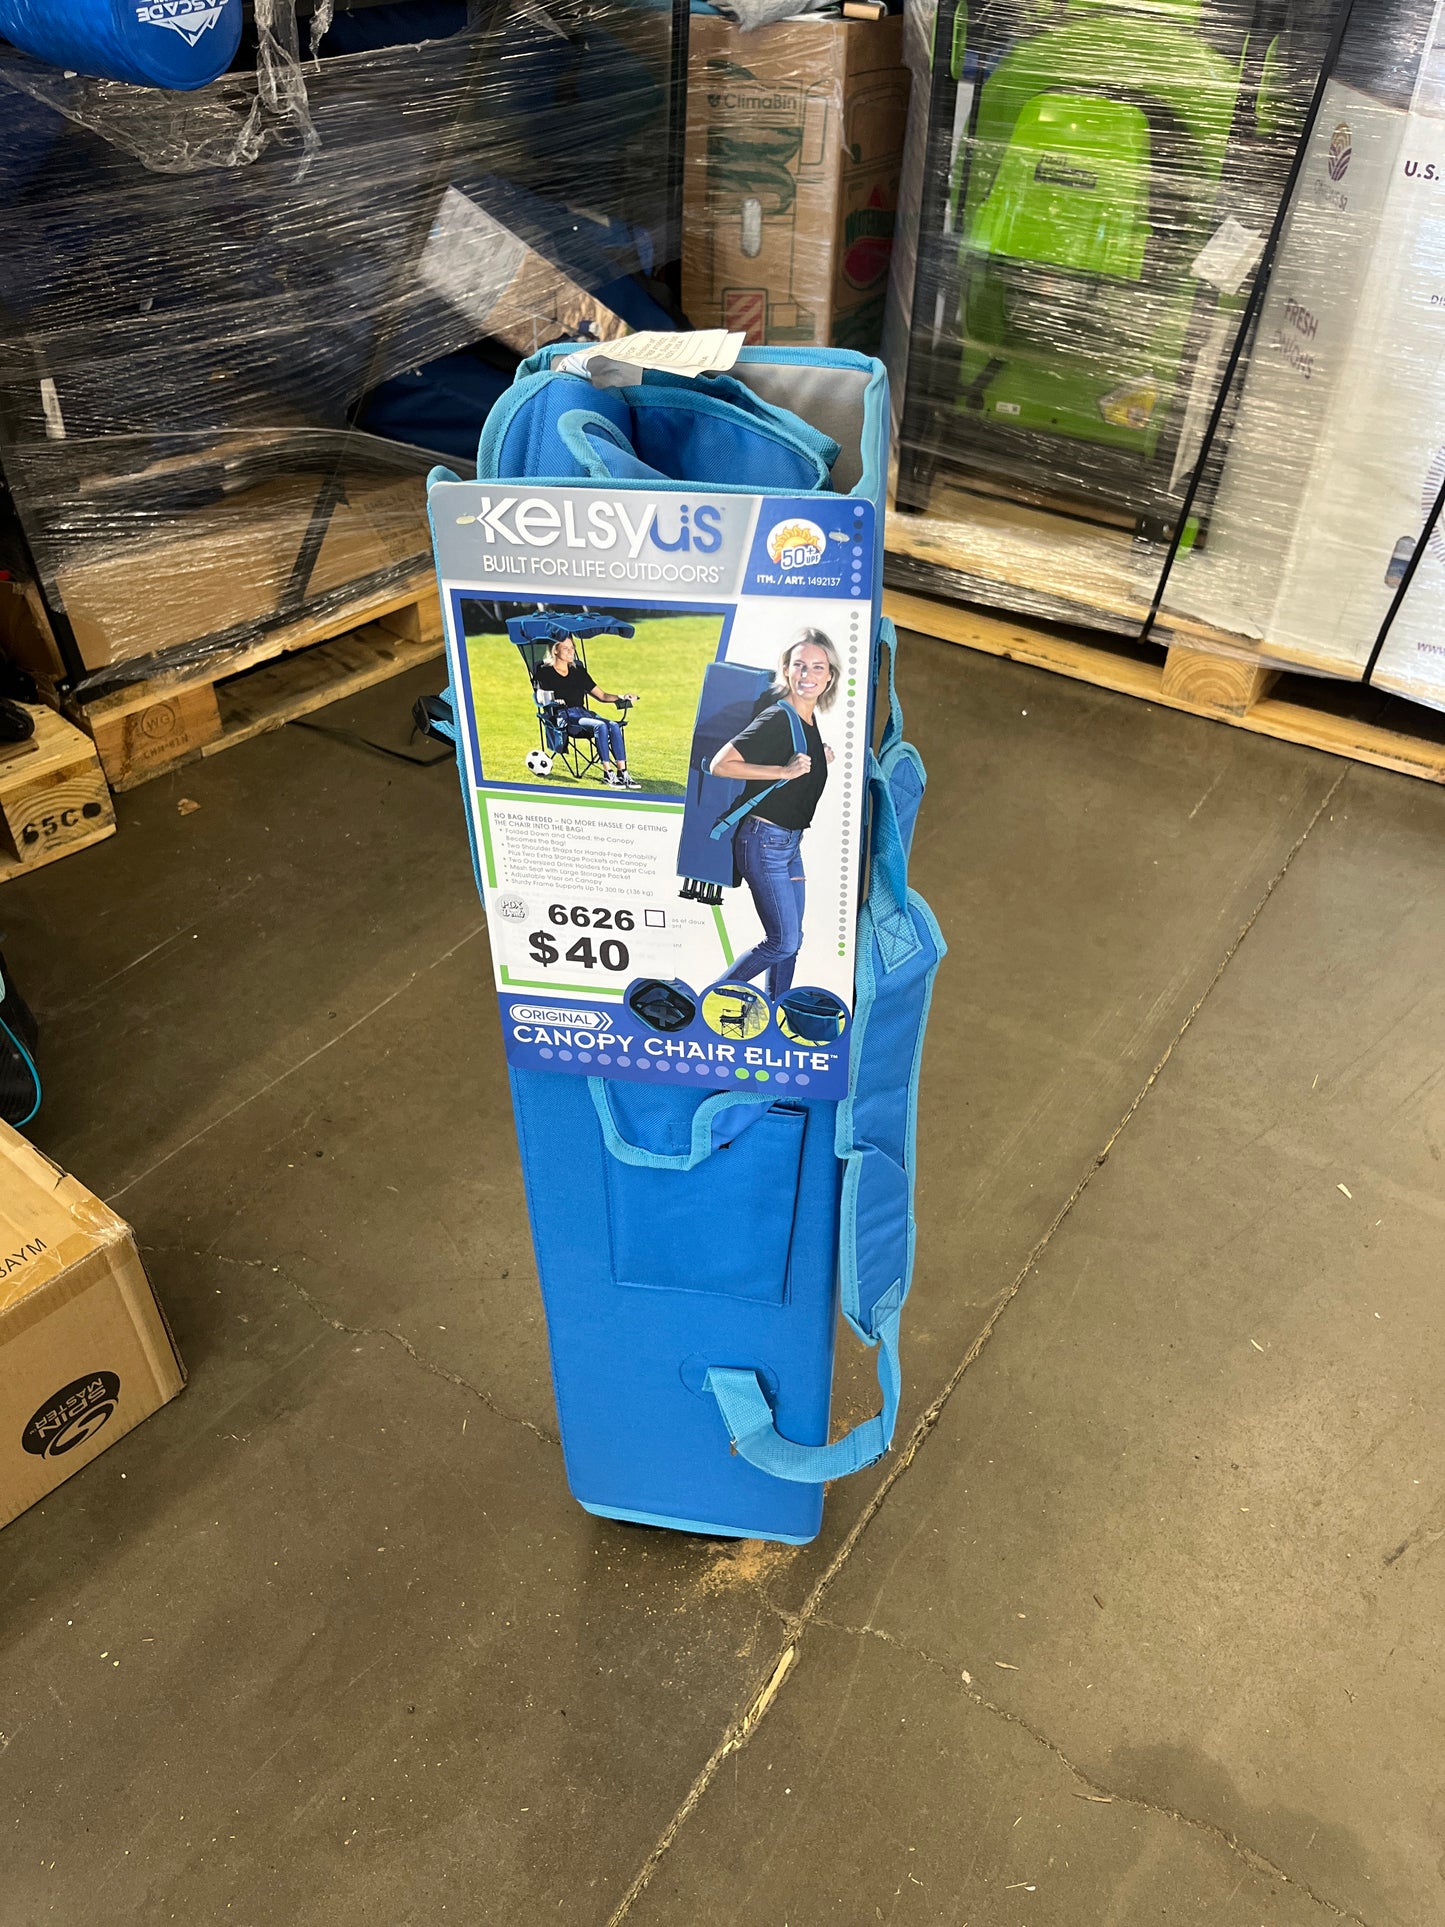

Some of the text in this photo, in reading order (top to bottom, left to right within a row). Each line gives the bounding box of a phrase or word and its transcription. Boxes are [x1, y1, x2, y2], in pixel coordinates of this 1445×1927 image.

[723, 92, 797, 110] ClimaBin
[1403, 160, 1440, 181] U.S.
[1430, 294, 1445, 306] DI
[1283, 297, 1319, 340] FRESH
[483, 555, 529, 575] BUILT
[531, 556, 570, 577] FOR
[572, 560, 606, 579] LIFE
[806, 555, 819, 564] UPF
[757, 575, 776, 584] ITM.
[784, 576, 806, 585] ART.
[807, 577, 841, 586] 1492137
[507, 813, 523, 821] BAG
[525, 815, 553, 823] NEEDED
[574, 819, 596, 827] MORE
[598, 821, 623, 829] HASSLE
[637, 824, 668, 832] GETTING
[508, 820, 531, 828] CHAIR
[506, 835, 537, 843] Becomes
[606, 836, 635, 845] Canopy
[508, 849, 521, 857] Plus
[553, 854, 580, 862] Storage
[581, 856, 607, 864] Pockets
[619, 859, 647, 868] Canopy
[521, 843, 551, 852] Shoulder
[552, 846, 572, 855] Straps
[584, 849, 622, 858] Hands-Free
[623, 852, 657, 862] Portability
[523, 858, 555, 867] Oversized
[575, 863, 600, 871] Holders
[612, 866, 637, 874] Largest
[637, 868, 656, 876] Cups
[559, 869, 579, 877] Large
[580, 870, 606, 879] Storage
[510, 871, 546, 880] Adjustable
[546, 874, 564, 882] Visor
[575, 877, 602, 886] Canopy
[511, 878, 532, 886] Sturdy
[533, 880, 554, 888] Frame
[555, 882, 584, 891] Supports
[585, 884, 595, 892] Up
[548, 904, 635, 931] 6626
[528, 930, 630, 972] $40
[519, 1008, 592, 1026] ORIGINAL
[513, 1025, 633, 1052] CANOPY
[644, 1037, 735, 1063] CHAIR
[38, 1384, 106, 1439] SPIN
